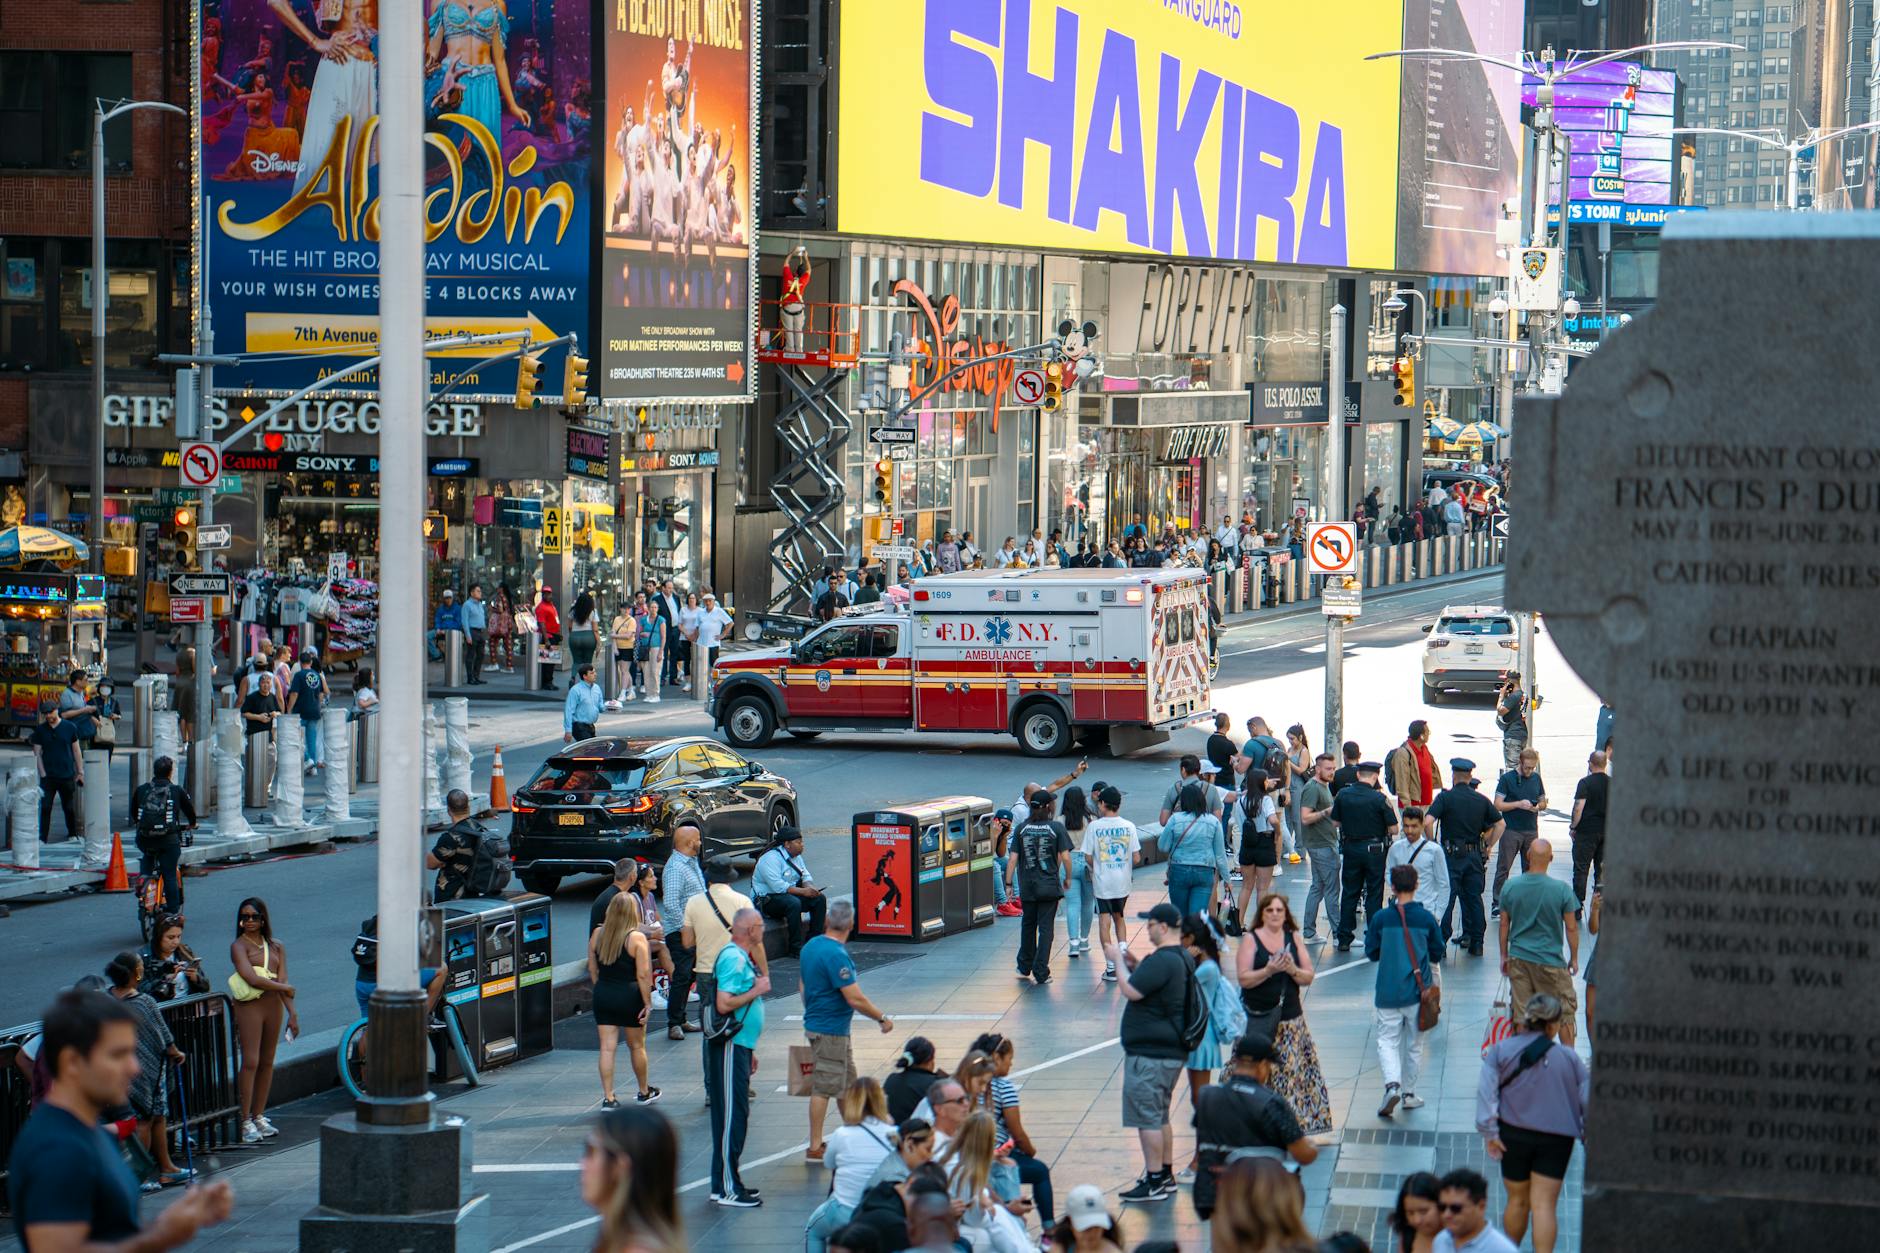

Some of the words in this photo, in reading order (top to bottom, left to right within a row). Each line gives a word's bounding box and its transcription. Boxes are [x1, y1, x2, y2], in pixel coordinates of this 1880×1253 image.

[703, 0, 743, 50] NOISE
[919, 0, 1348, 267] SHAKIRA
[218, 113, 574, 245] Alddin
[1585, 205, 1621, 219] TODAY
[248, 249, 287, 268] THE
[294, 250, 326, 268] HIT
[460, 253, 550, 271] MUSICAL
[221, 281, 265, 297] YOUR
[274, 282, 316, 298] WISH
[325, 284, 380, 299] COMES
[439, 286, 449, 299] 4
[457, 286, 522, 300] BLOCKS
[530, 287, 577, 301] AWAY
[294, 326, 318, 342] 7th
[322, 327, 377, 343] Avenue
[641, 326, 650, 335] THE
[650, 326, 663, 336] ONLY
[663, 327, 688, 336] BROADWAY
[689, 327, 703, 336] SHOW
[703, 327, 715, 336] WITH
[609, 340, 628, 351] FOUR
[629, 340, 657, 351] MATINEE
[658, 340, 710, 352] PERFORMANCES
[711, 341, 723, 351] PER
[723, 341, 743, 352] WEEK!
[614, 367, 656, 379] BROADHURST
[656, 367, 683, 379] THEATRE
[684, 367, 694, 378] 235
[695, 367, 701, 377] W
[701, 367, 716, 378] 44TH
[1264, 388, 1279, 408] U.S.
[1279, 387, 1301, 407] POLO
[1301, 386, 1323, 407] ASSN.
[103, 394, 229, 431] GIFS
[265, 399, 481, 437] LUGGGE
[284, 434, 322, 453] NY
[877, 431, 889, 439] ONE
[896, 431, 910, 439] WAY
[1164, 427, 1214, 461] FOREVER
[119, 455, 147, 467] Apple
[222, 453, 280, 469] Canon
[296, 456, 355, 472] SONY
[435, 462, 467, 473] SAMSUNG
[669, 453, 697, 467] SONY
[1635, 443, 1787, 470] LIEUTENANT
[161, 491, 168, 504] W
[171, 491, 183, 505] 46
[1614, 476, 1765, 511] FRANCIS
[199, 532, 209, 543] ONE
[214, 531, 226, 542] WAY
[547, 510, 558, 547] ATM
[1632, 518, 1679, 540] MAY
[1838, 522, 1867, 544] 26
[178, 579, 194, 589] ONE
[203, 578, 222, 589] WAY
[1653, 560, 1787, 586] CATHOLIC
[931, 590, 952, 599] 1609
[941, 622, 979, 641] F.D.
[1018, 623, 1058, 641] N.Y.
[1709, 624, 1838, 649] CHAPLAIN
[964, 649, 1032, 661] AMBULANCE
[1166, 643, 1194, 658] AMBULANCE
[1651, 660, 1718, 682] 165TH
[1682, 693, 1735, 715] OLD
[1743, 695, 1800, 716] 69TH
[1651, 756, 1670, 779] A
[1681, 757, 1734, 782] LIFE
[1743, 758, 1778, 783] OF
[1748, 786, 1790, 806] FOR
[1640, 805, 1700, 829] GOD
[1708, 809, 1766, 832] AND
[1633, 870, 1721, 893] SPANISH
[1728, 873, 1848, 898] AMERICAN
[1602, 899, 1654, 919] NEW
[1661, 901, 1722, 923] YORK
[1729, 904, 1846, 929] NATIONAL
[1663, 931, 1768, 955] MEXICAN
[1777, 936, 1871, 961] BORDER
[1690, 962, 1775, 986] WORLD
[1596, 1020, 1760, 1048] DISTINGUISHED
[1769, 1029, 1855, 1053] SERVICE
[1595, 1052, 1760, 1078] DISTINGUISHED
[1768, 1060, 1857, 1084] SERVICE
[1594, 1079, 1757, 1109] CONSPICUOUS
[1768, 1091, 1856, 1115] SERVICE
[1652, 1144, 1728, 1168] CROIX
[1740, 1150, 1773, 1170] DE
